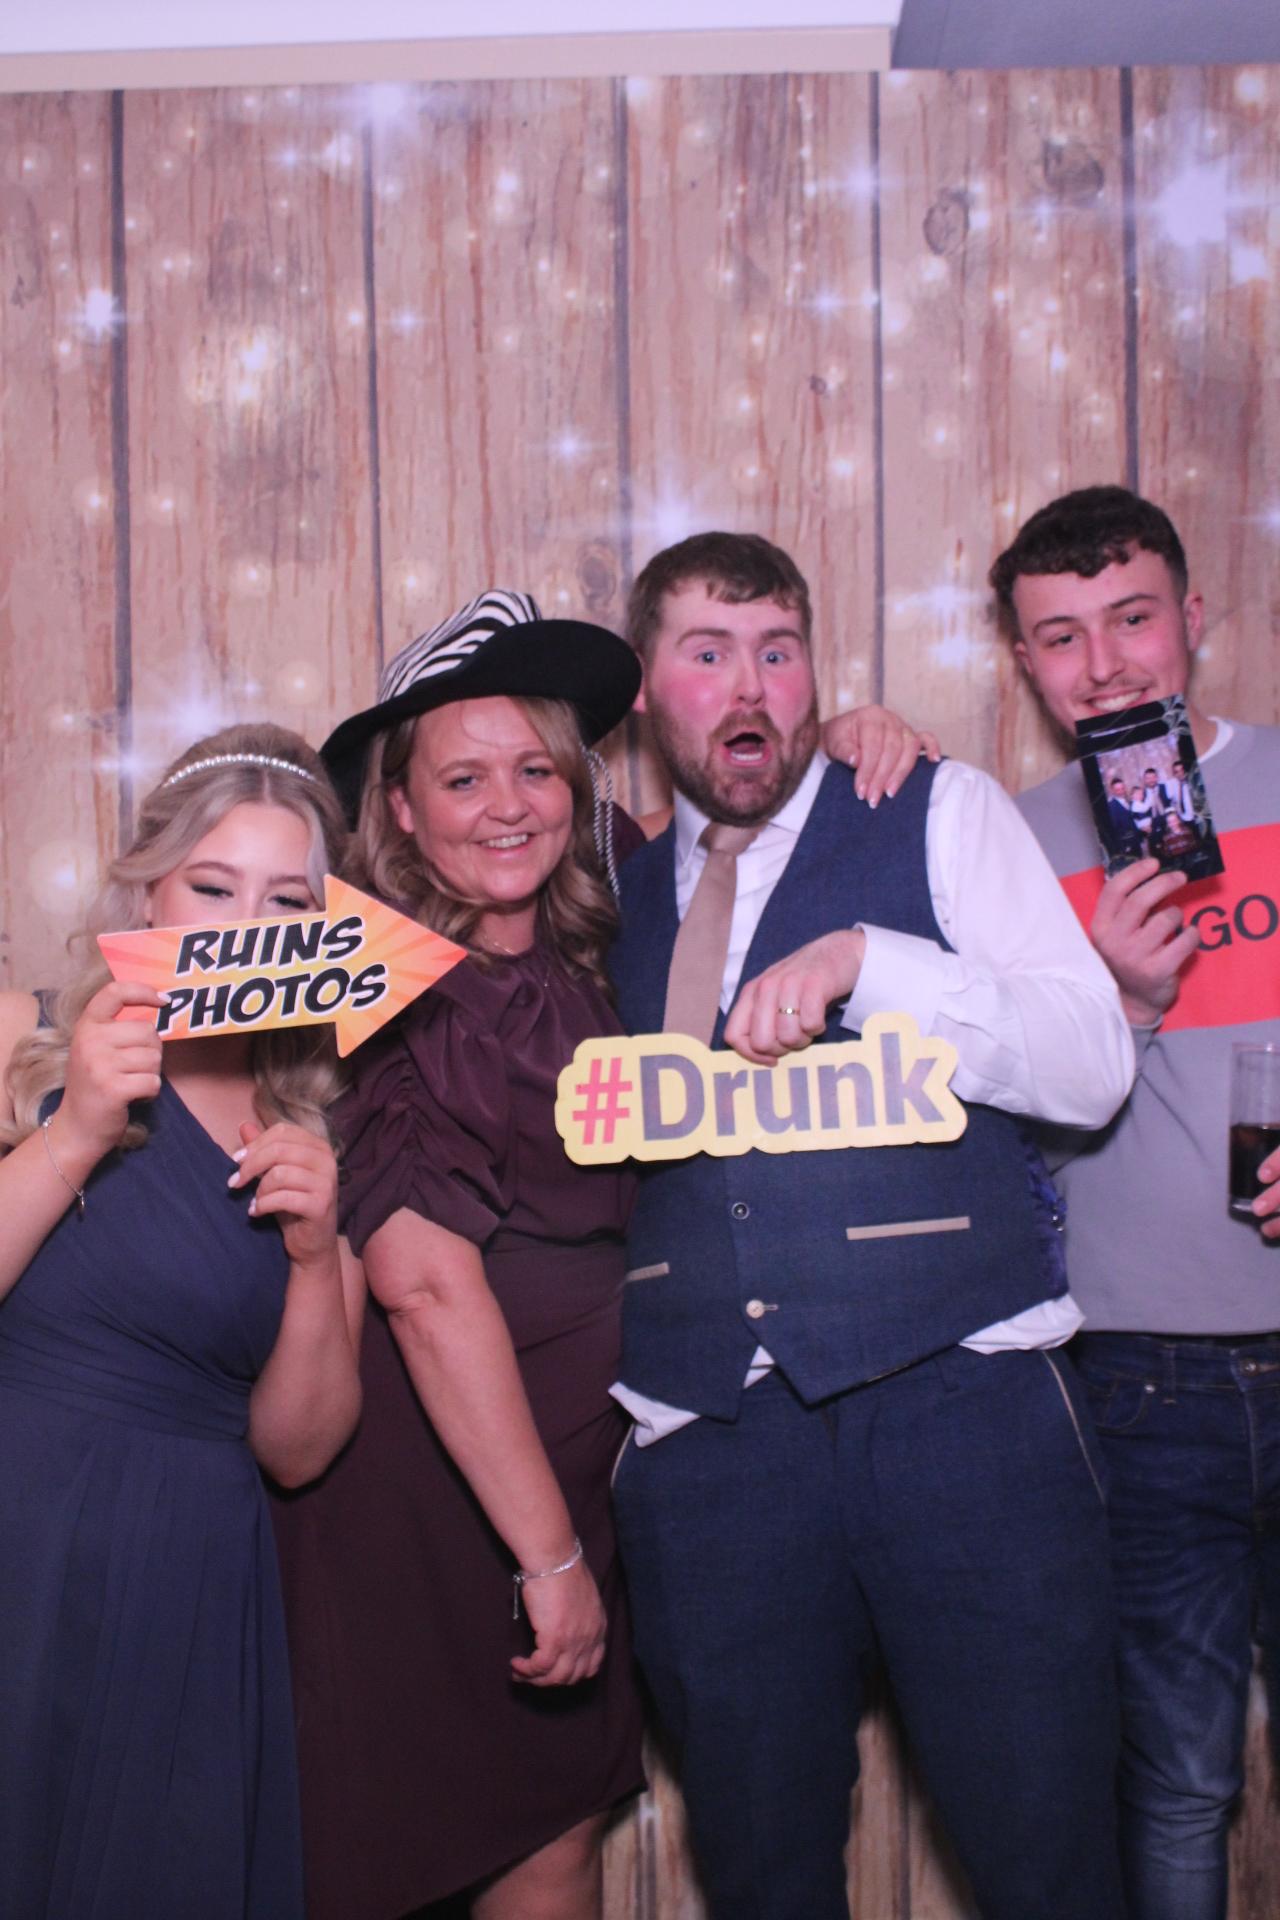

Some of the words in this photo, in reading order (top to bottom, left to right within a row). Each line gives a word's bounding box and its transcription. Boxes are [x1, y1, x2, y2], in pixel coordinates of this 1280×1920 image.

[175, 916, 363, 975] RUINS
[1175, 894, 1279, 951] GO
[156, 963, 386, 1032] PHOTOS
[572, 1032, 946, 1146] #Drunk
